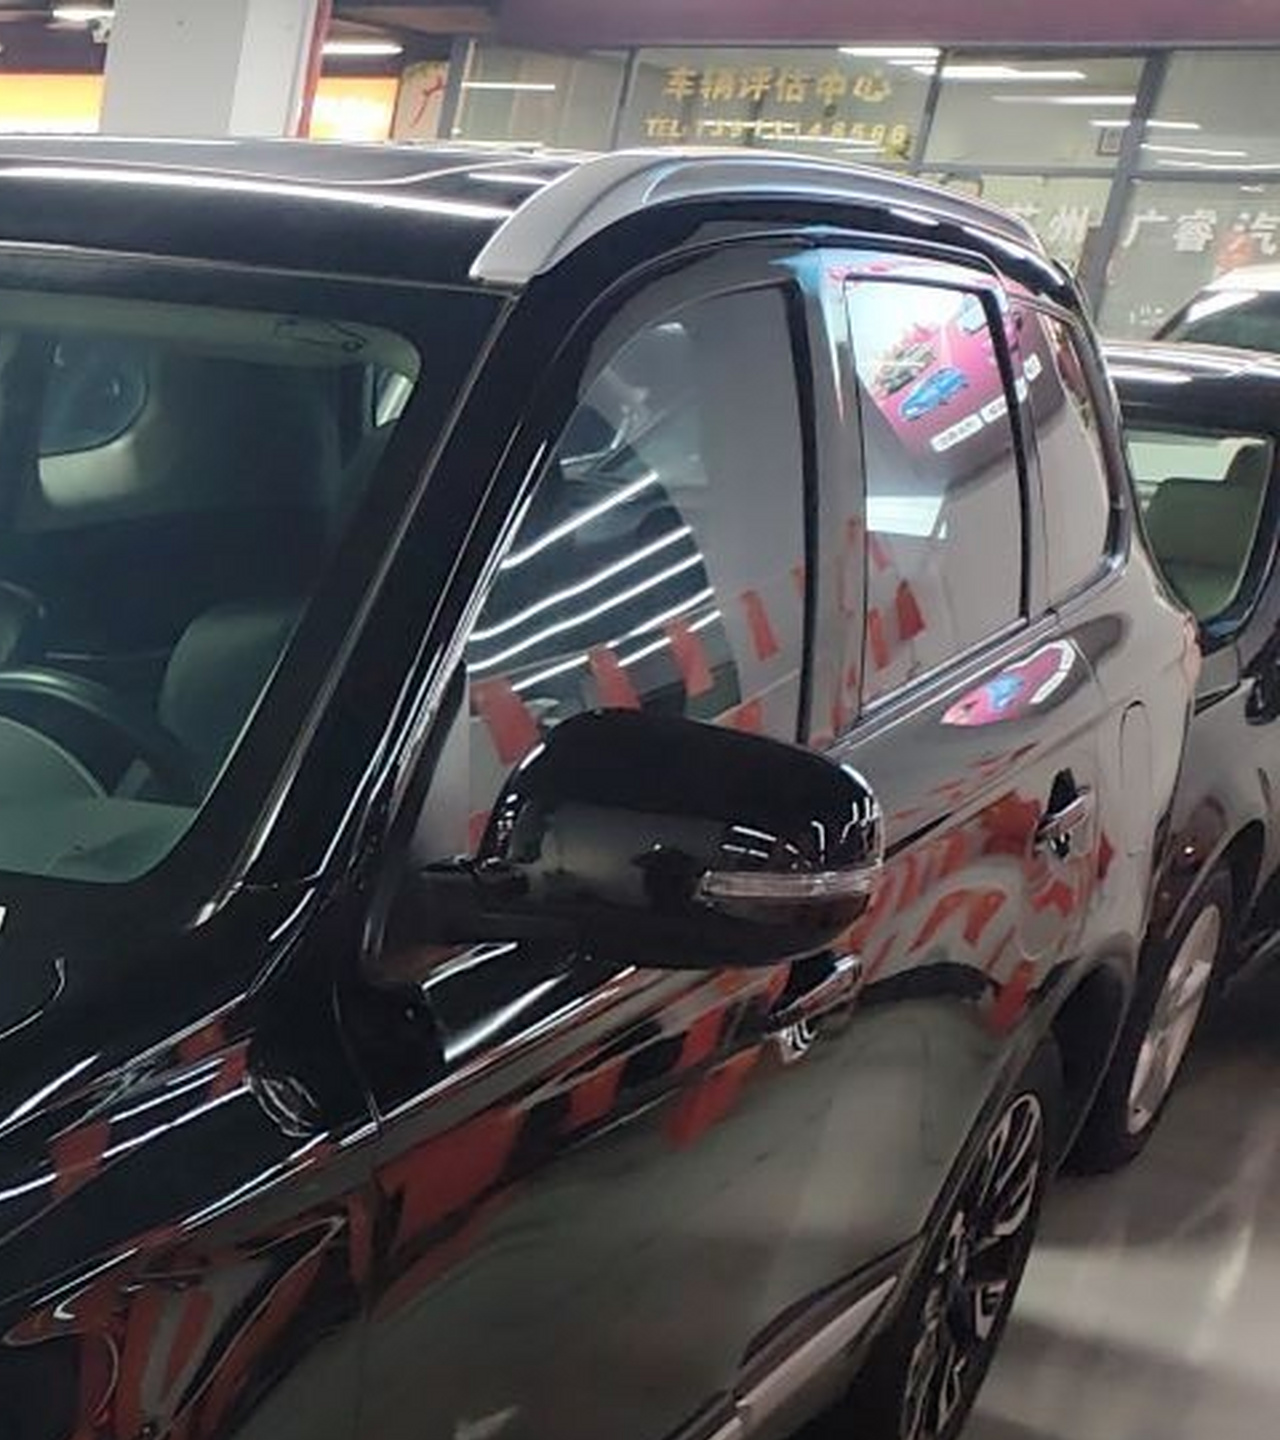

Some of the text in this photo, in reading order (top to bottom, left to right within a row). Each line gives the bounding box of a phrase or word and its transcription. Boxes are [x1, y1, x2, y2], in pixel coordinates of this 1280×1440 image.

[662, 66, 893, 105] 车辆评估中心
